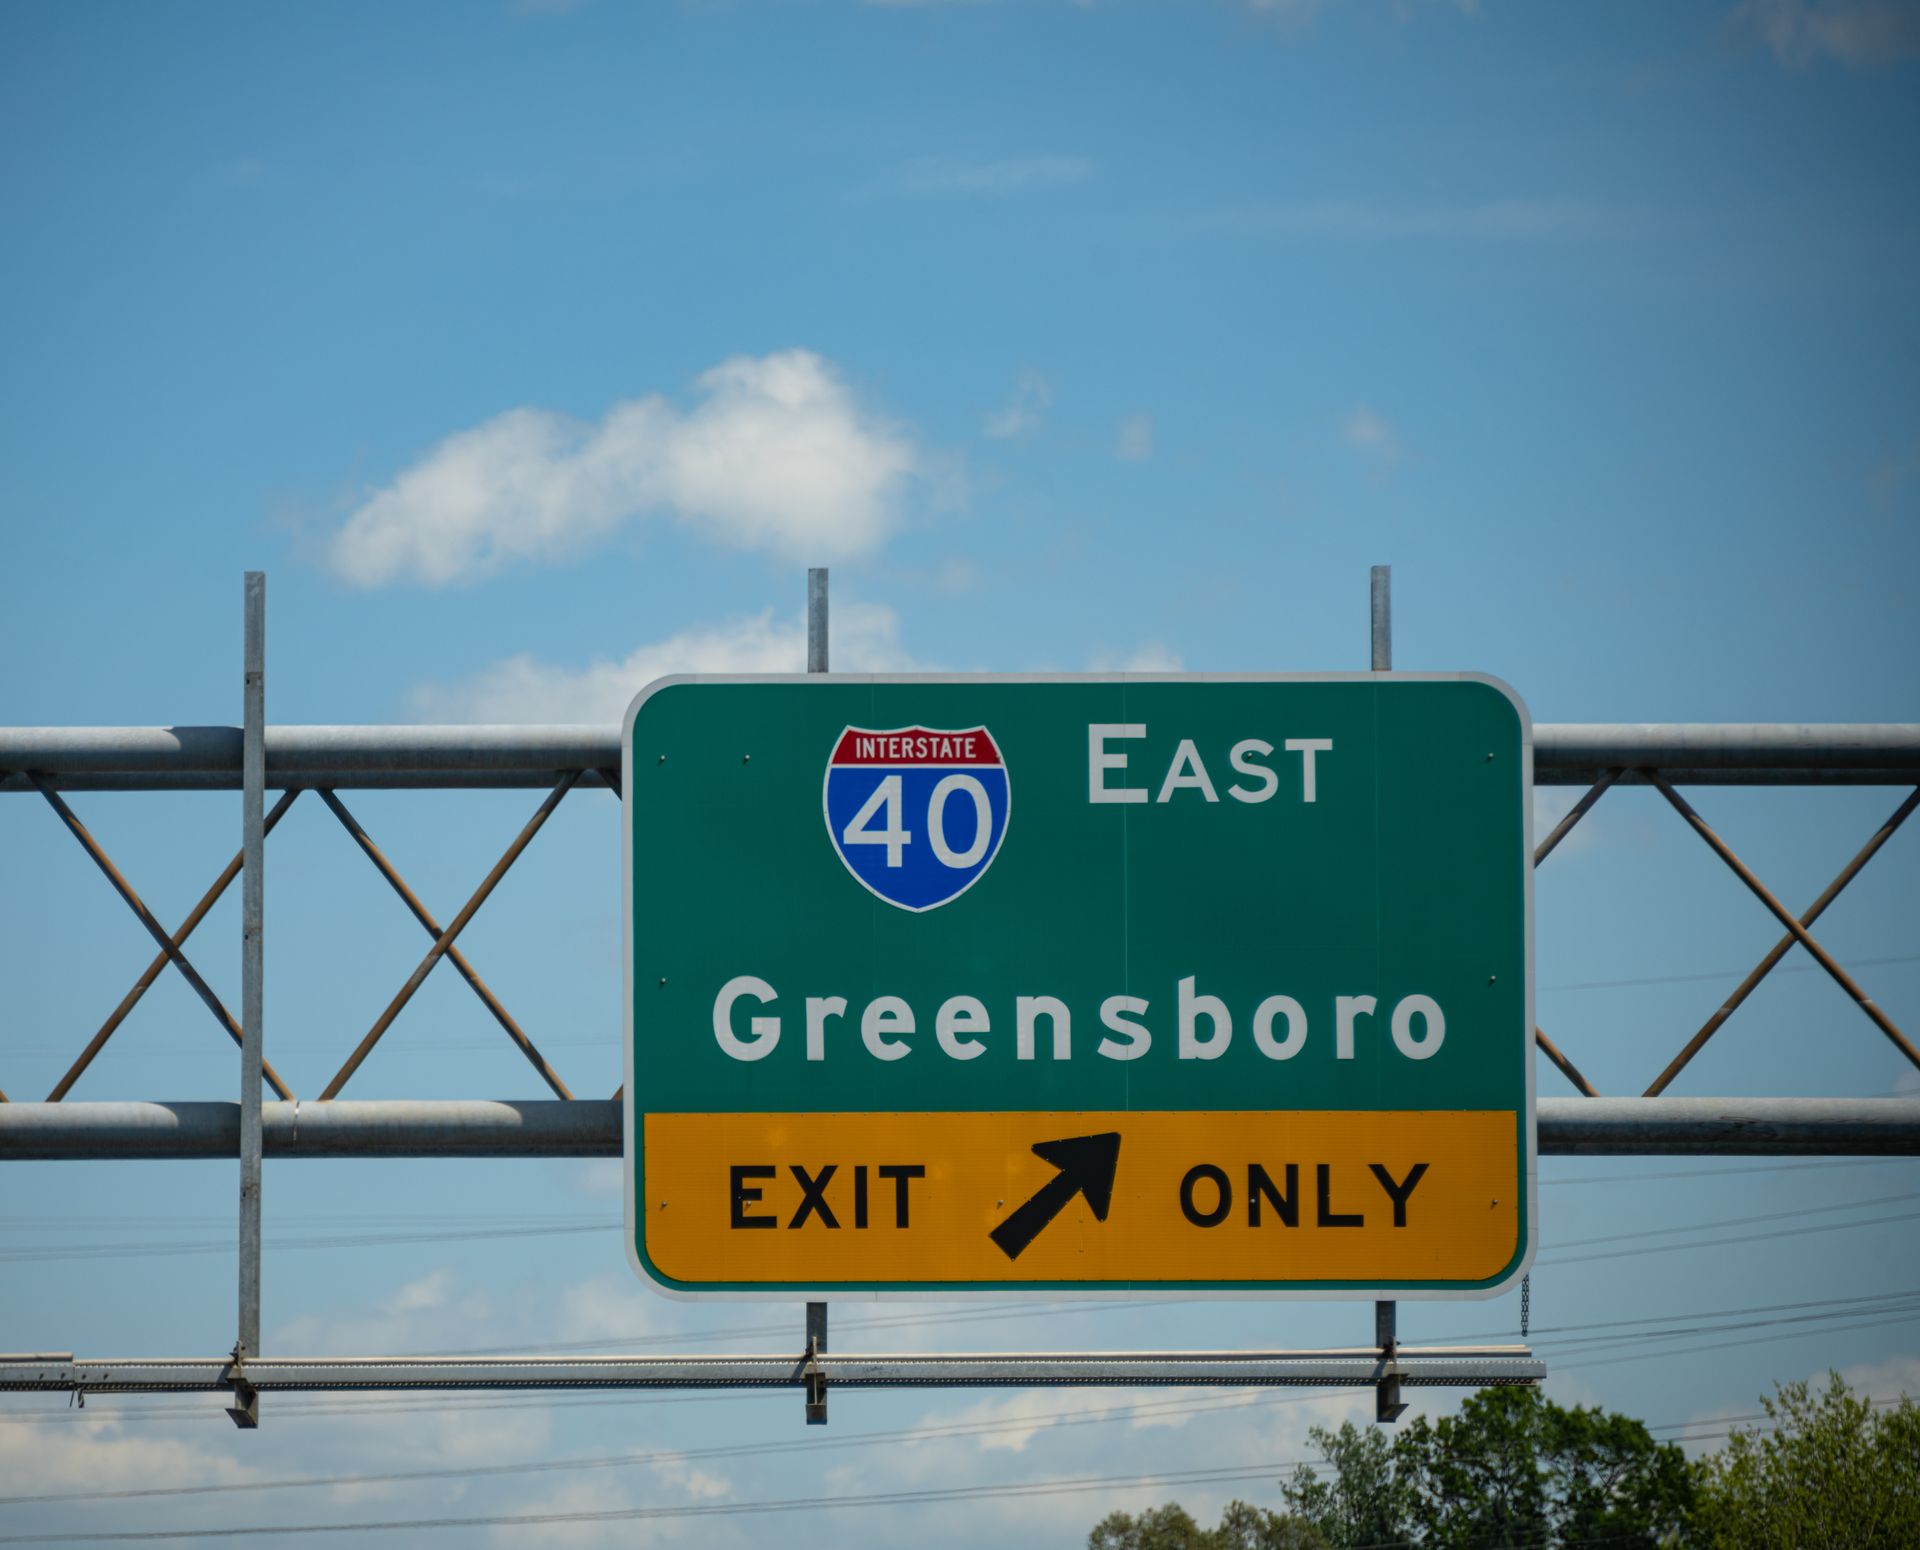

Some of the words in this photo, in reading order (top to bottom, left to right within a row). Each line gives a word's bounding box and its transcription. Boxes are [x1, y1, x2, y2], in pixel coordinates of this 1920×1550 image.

[854, 736, 978, 760] INTERSTATE
[1088, 722, 1333, 804] EAST
[843, 774, 992, 870] 40
[712, 975, 1447, 1062] Greensboro
[730, 1164, 926, 1230] EXIT
[1179, 1162, 1431, 1229] ONLY
